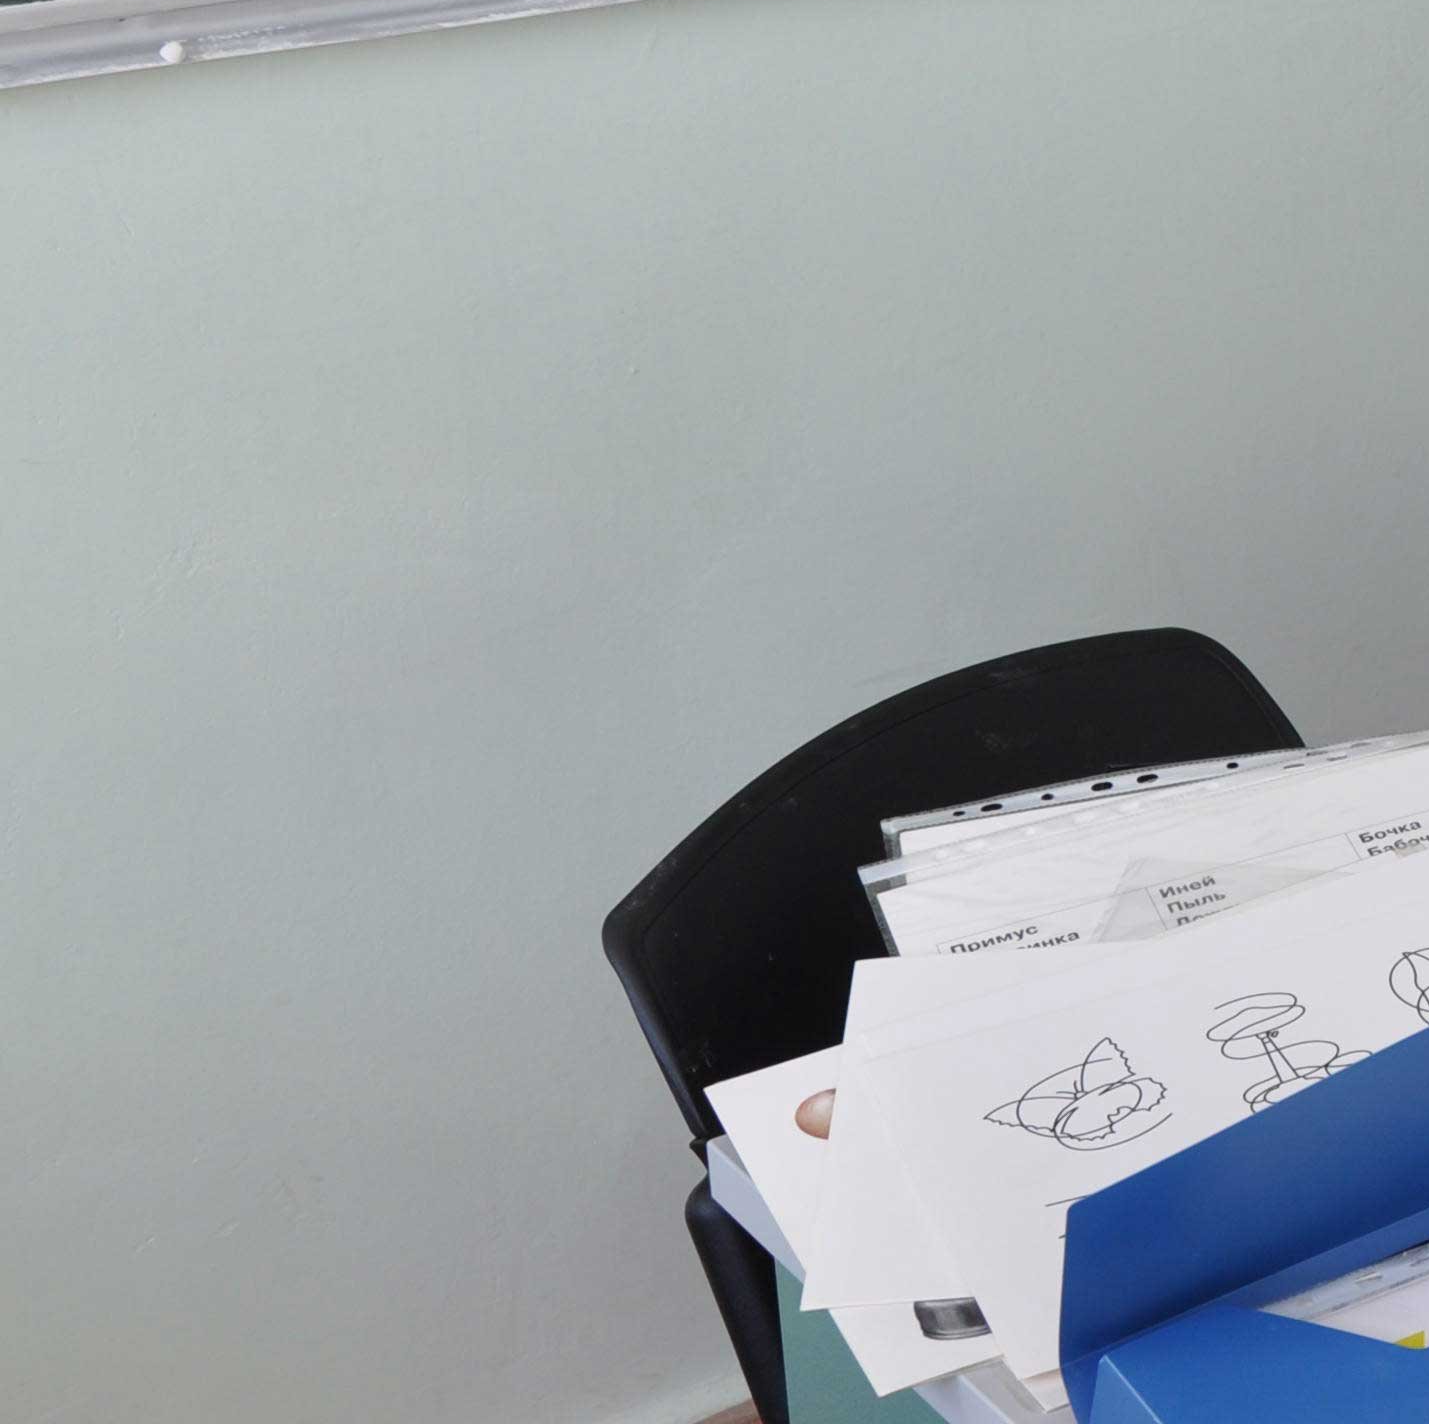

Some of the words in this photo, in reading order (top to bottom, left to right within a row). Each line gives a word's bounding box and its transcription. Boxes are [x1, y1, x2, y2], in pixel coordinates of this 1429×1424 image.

[1358, 819, 1422, 844] Бочка
[1159, 875, 1216, 898] Иней
[1166, 890, 1227, 914] Пыль
[950, 925, 1039, 954] Примус
